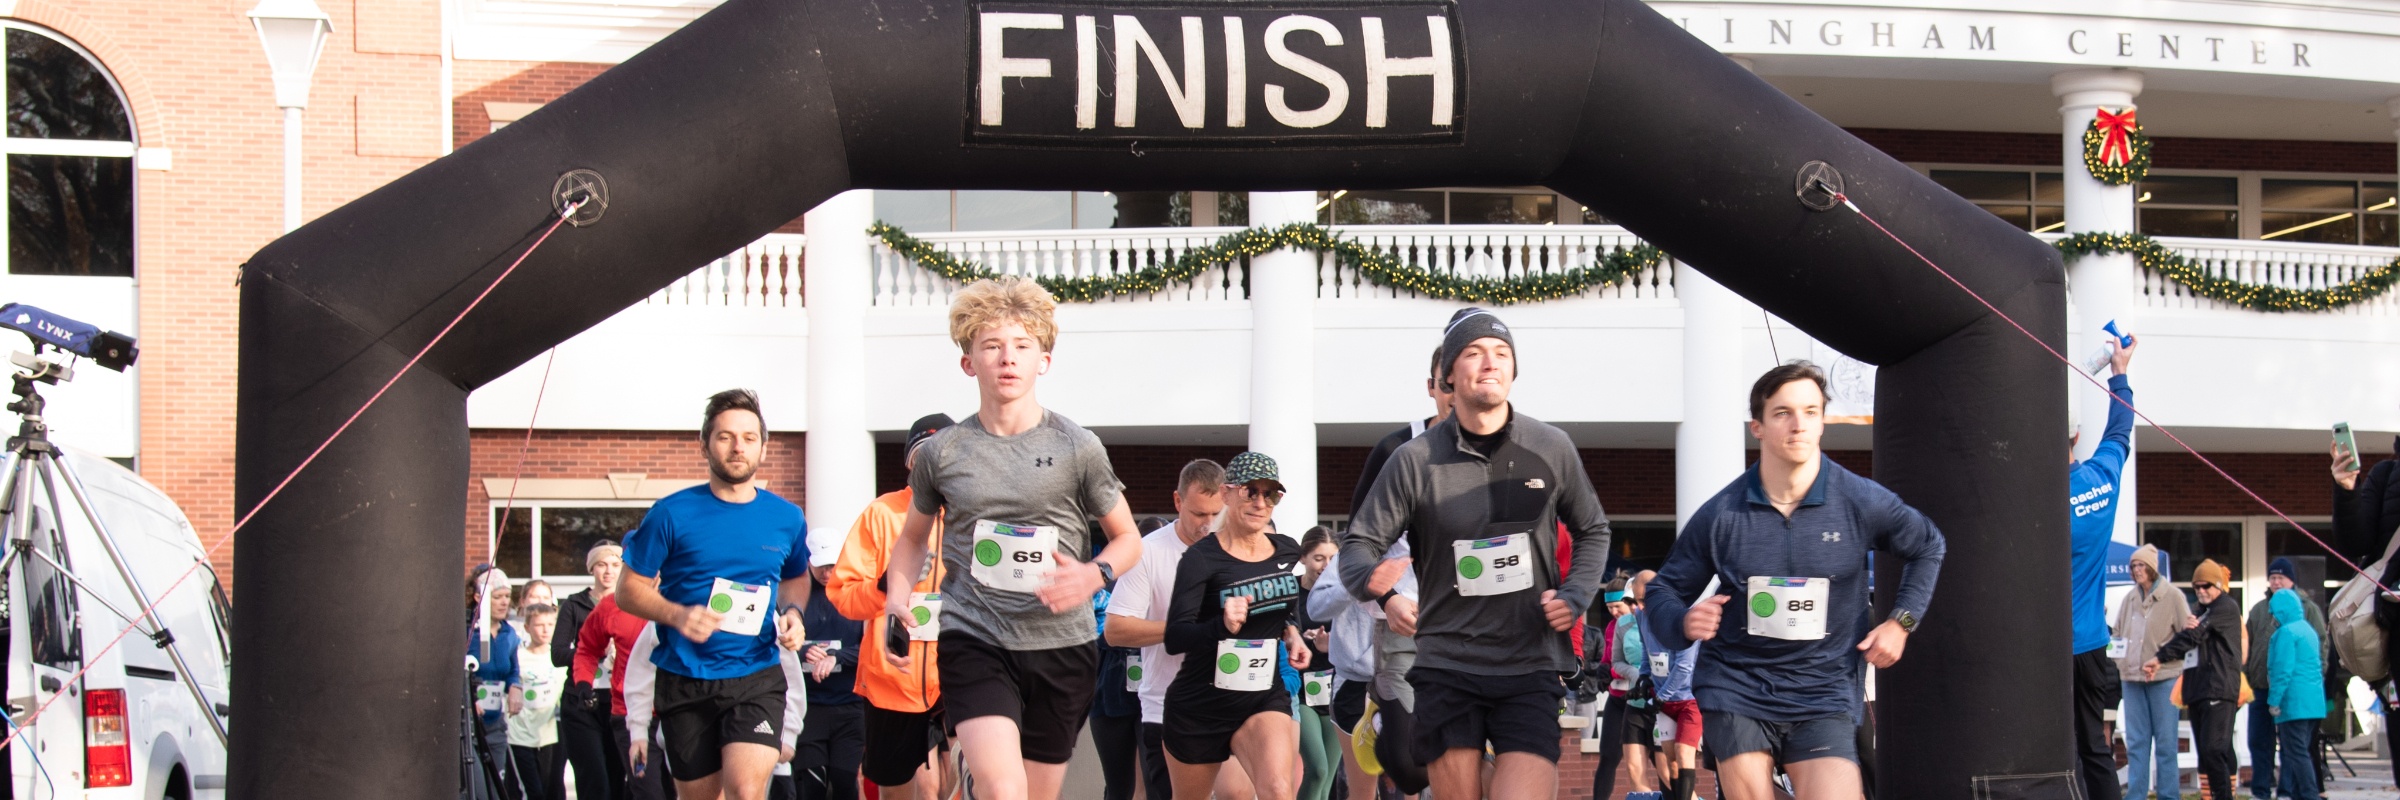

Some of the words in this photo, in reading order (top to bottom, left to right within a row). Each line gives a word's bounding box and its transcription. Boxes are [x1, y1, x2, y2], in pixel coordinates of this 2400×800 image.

[2067, 29, 2312, 67] CENTER
[980, 12, 1454, 129] FINISH
[37, 319, 74, 341] LYNX
[2075, 497, 2109, 517] Crew
[1013, 551, 1043, 563] 69
[1493, 555, 1519, 569] 58
[746, 604, 755, 612] 4
[1788, 600, 1814, 611] 88
[1249, 658, 1268, 668] 27
